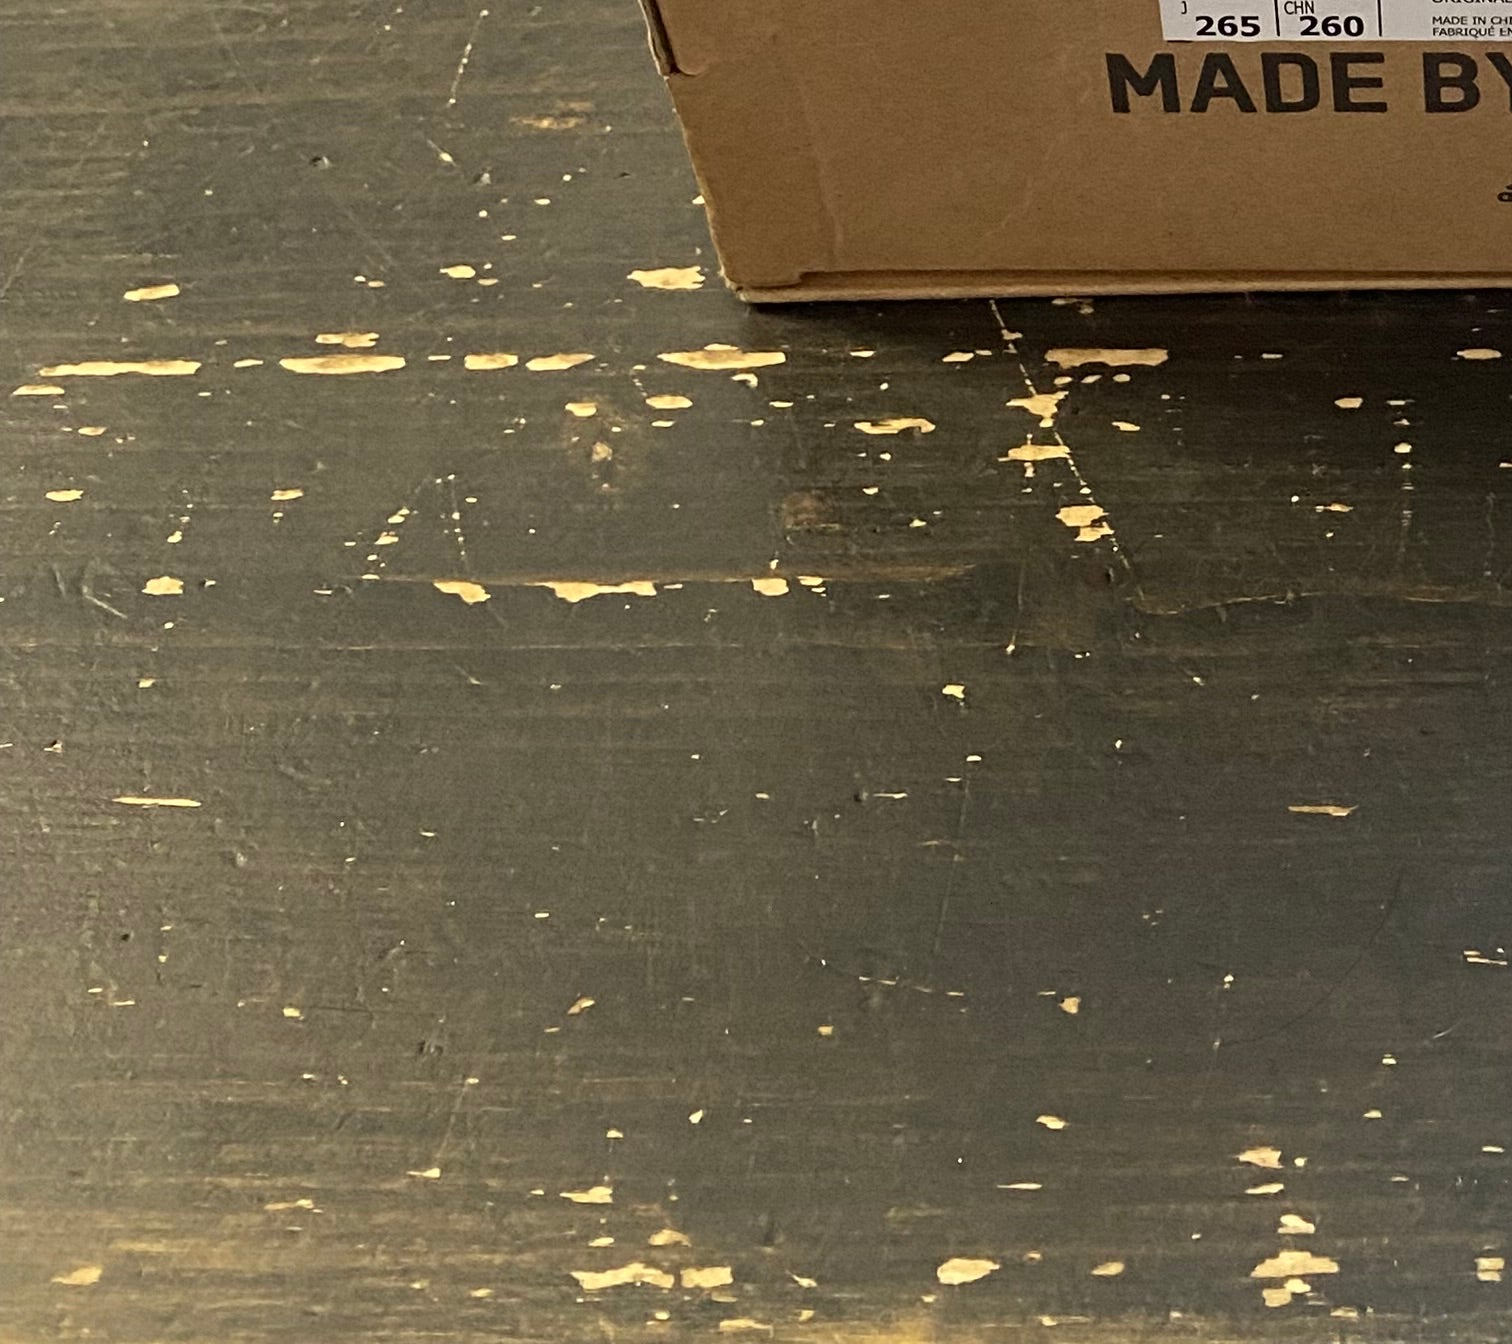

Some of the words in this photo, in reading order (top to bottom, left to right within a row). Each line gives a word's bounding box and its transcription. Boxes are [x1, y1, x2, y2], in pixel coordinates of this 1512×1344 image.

[1283, 0, 1315, 15] CHN
[1195, 15, 1261, 37] 265
[1299, 15, 1365, 37] 260
[1432, 16, 1468, 25] MADE
[1472, 16, 1487, 25] IN
[1432, 26, 1496, 38] FABRIQUÉ
[1104, 53, 1388, 113] MADE
